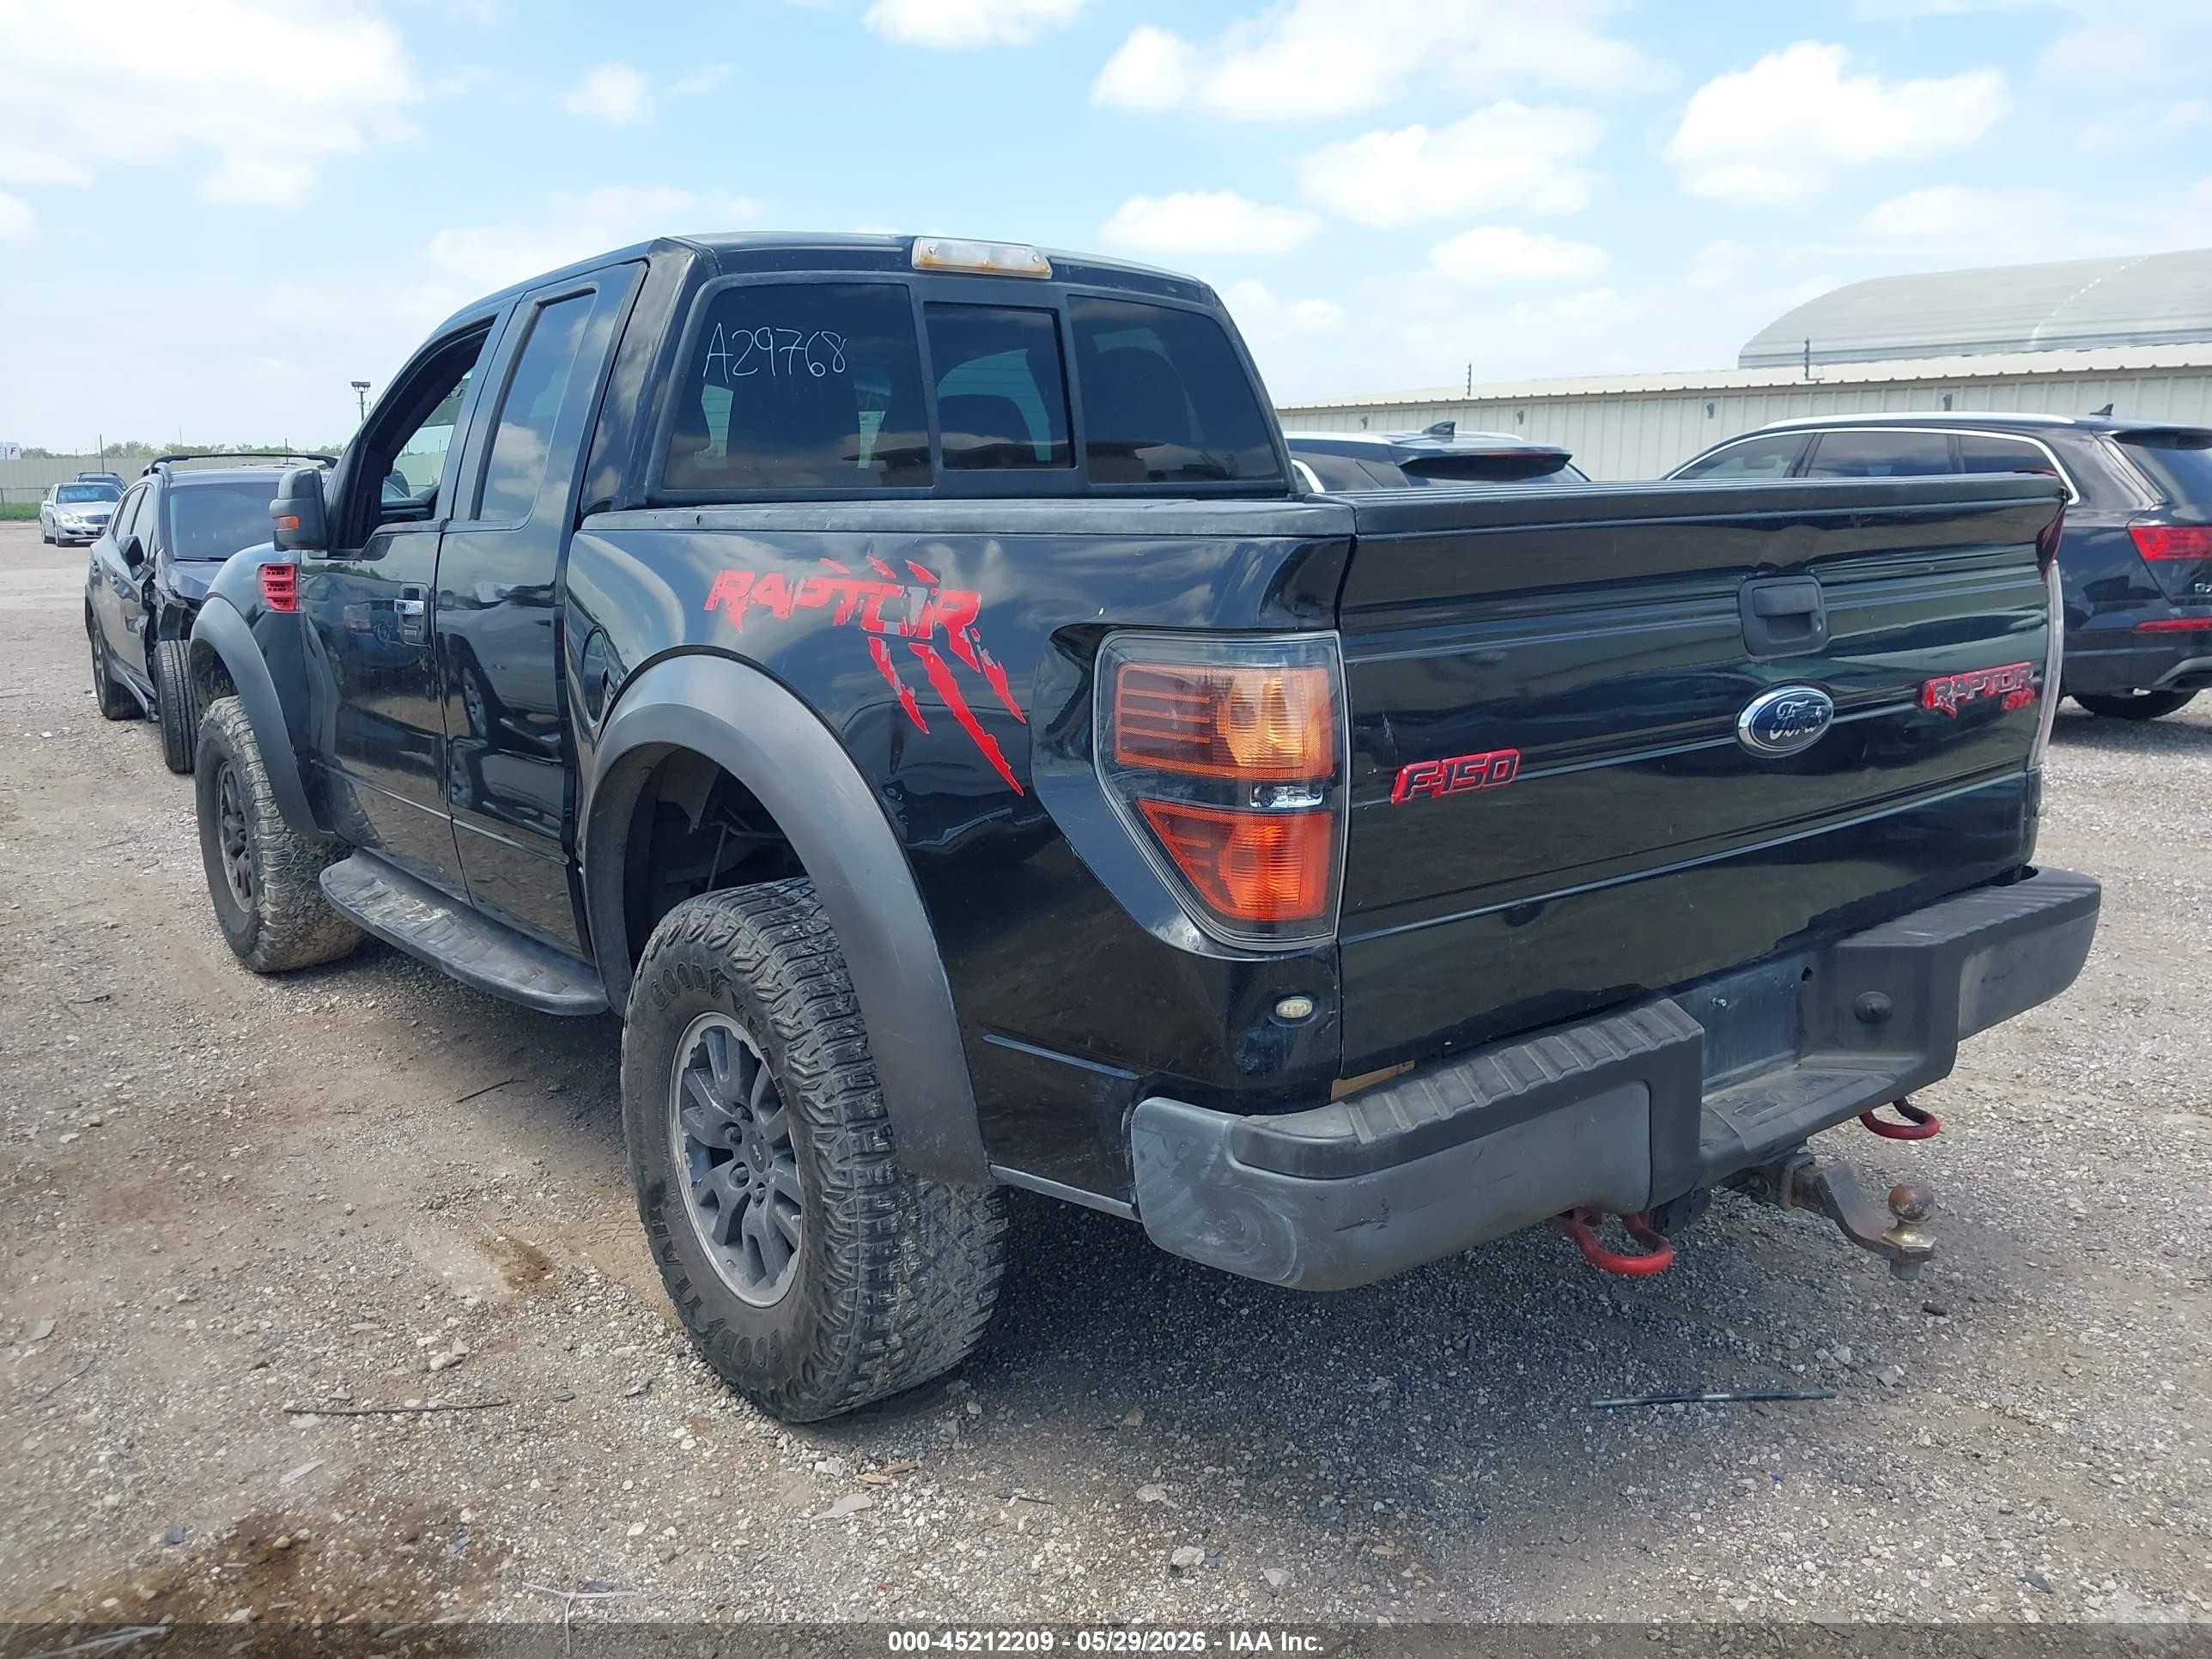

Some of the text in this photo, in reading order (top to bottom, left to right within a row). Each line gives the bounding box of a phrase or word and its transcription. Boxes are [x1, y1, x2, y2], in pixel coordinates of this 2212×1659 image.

[702, 321, 848, 384] A29768
[703, 568, 982, 673] RAPTOR
[1923, 661, 2034, 719] RAPTOR
[1769, 699, 1822, 740] Ford
[1391, 749, 1520, 804] F-150
